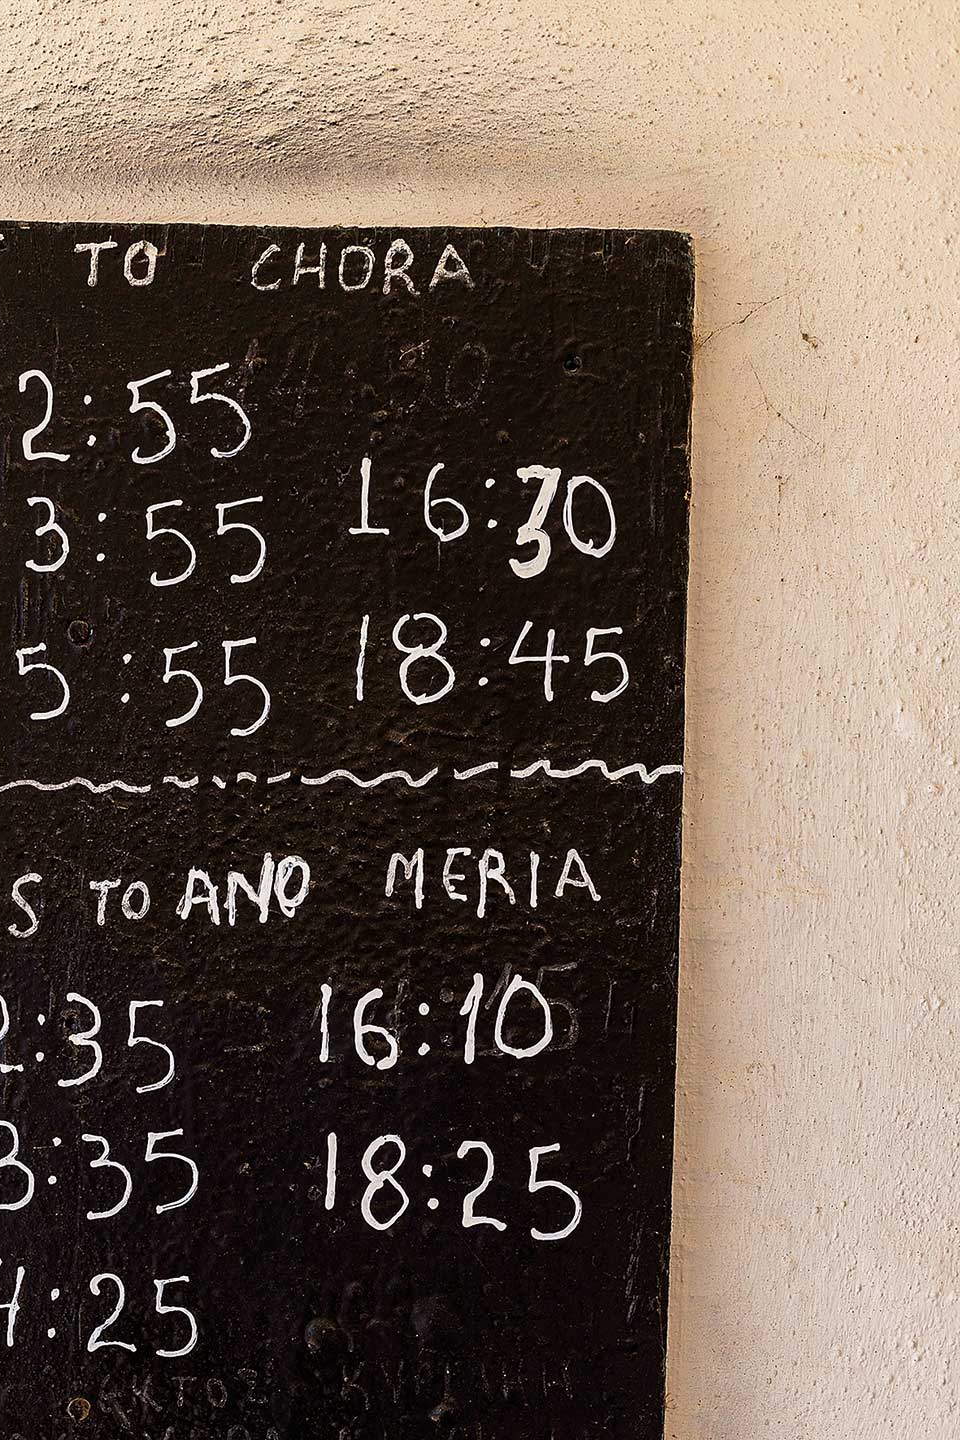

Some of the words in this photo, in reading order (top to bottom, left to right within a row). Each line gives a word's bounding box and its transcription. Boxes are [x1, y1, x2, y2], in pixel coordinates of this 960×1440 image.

[73, 235, 159, 287] TO
[250, 238, 470, 295] CHORA
[355, 612, 630, 706] 18:45
[88, 878, 151, 927] TO
[175, 851, 311, 927] ANO
[384, 847, 602, 919] MERIA
[319, 972, 554, 1071] 16:10
[324, 1131, 583, 1241] 18:25
